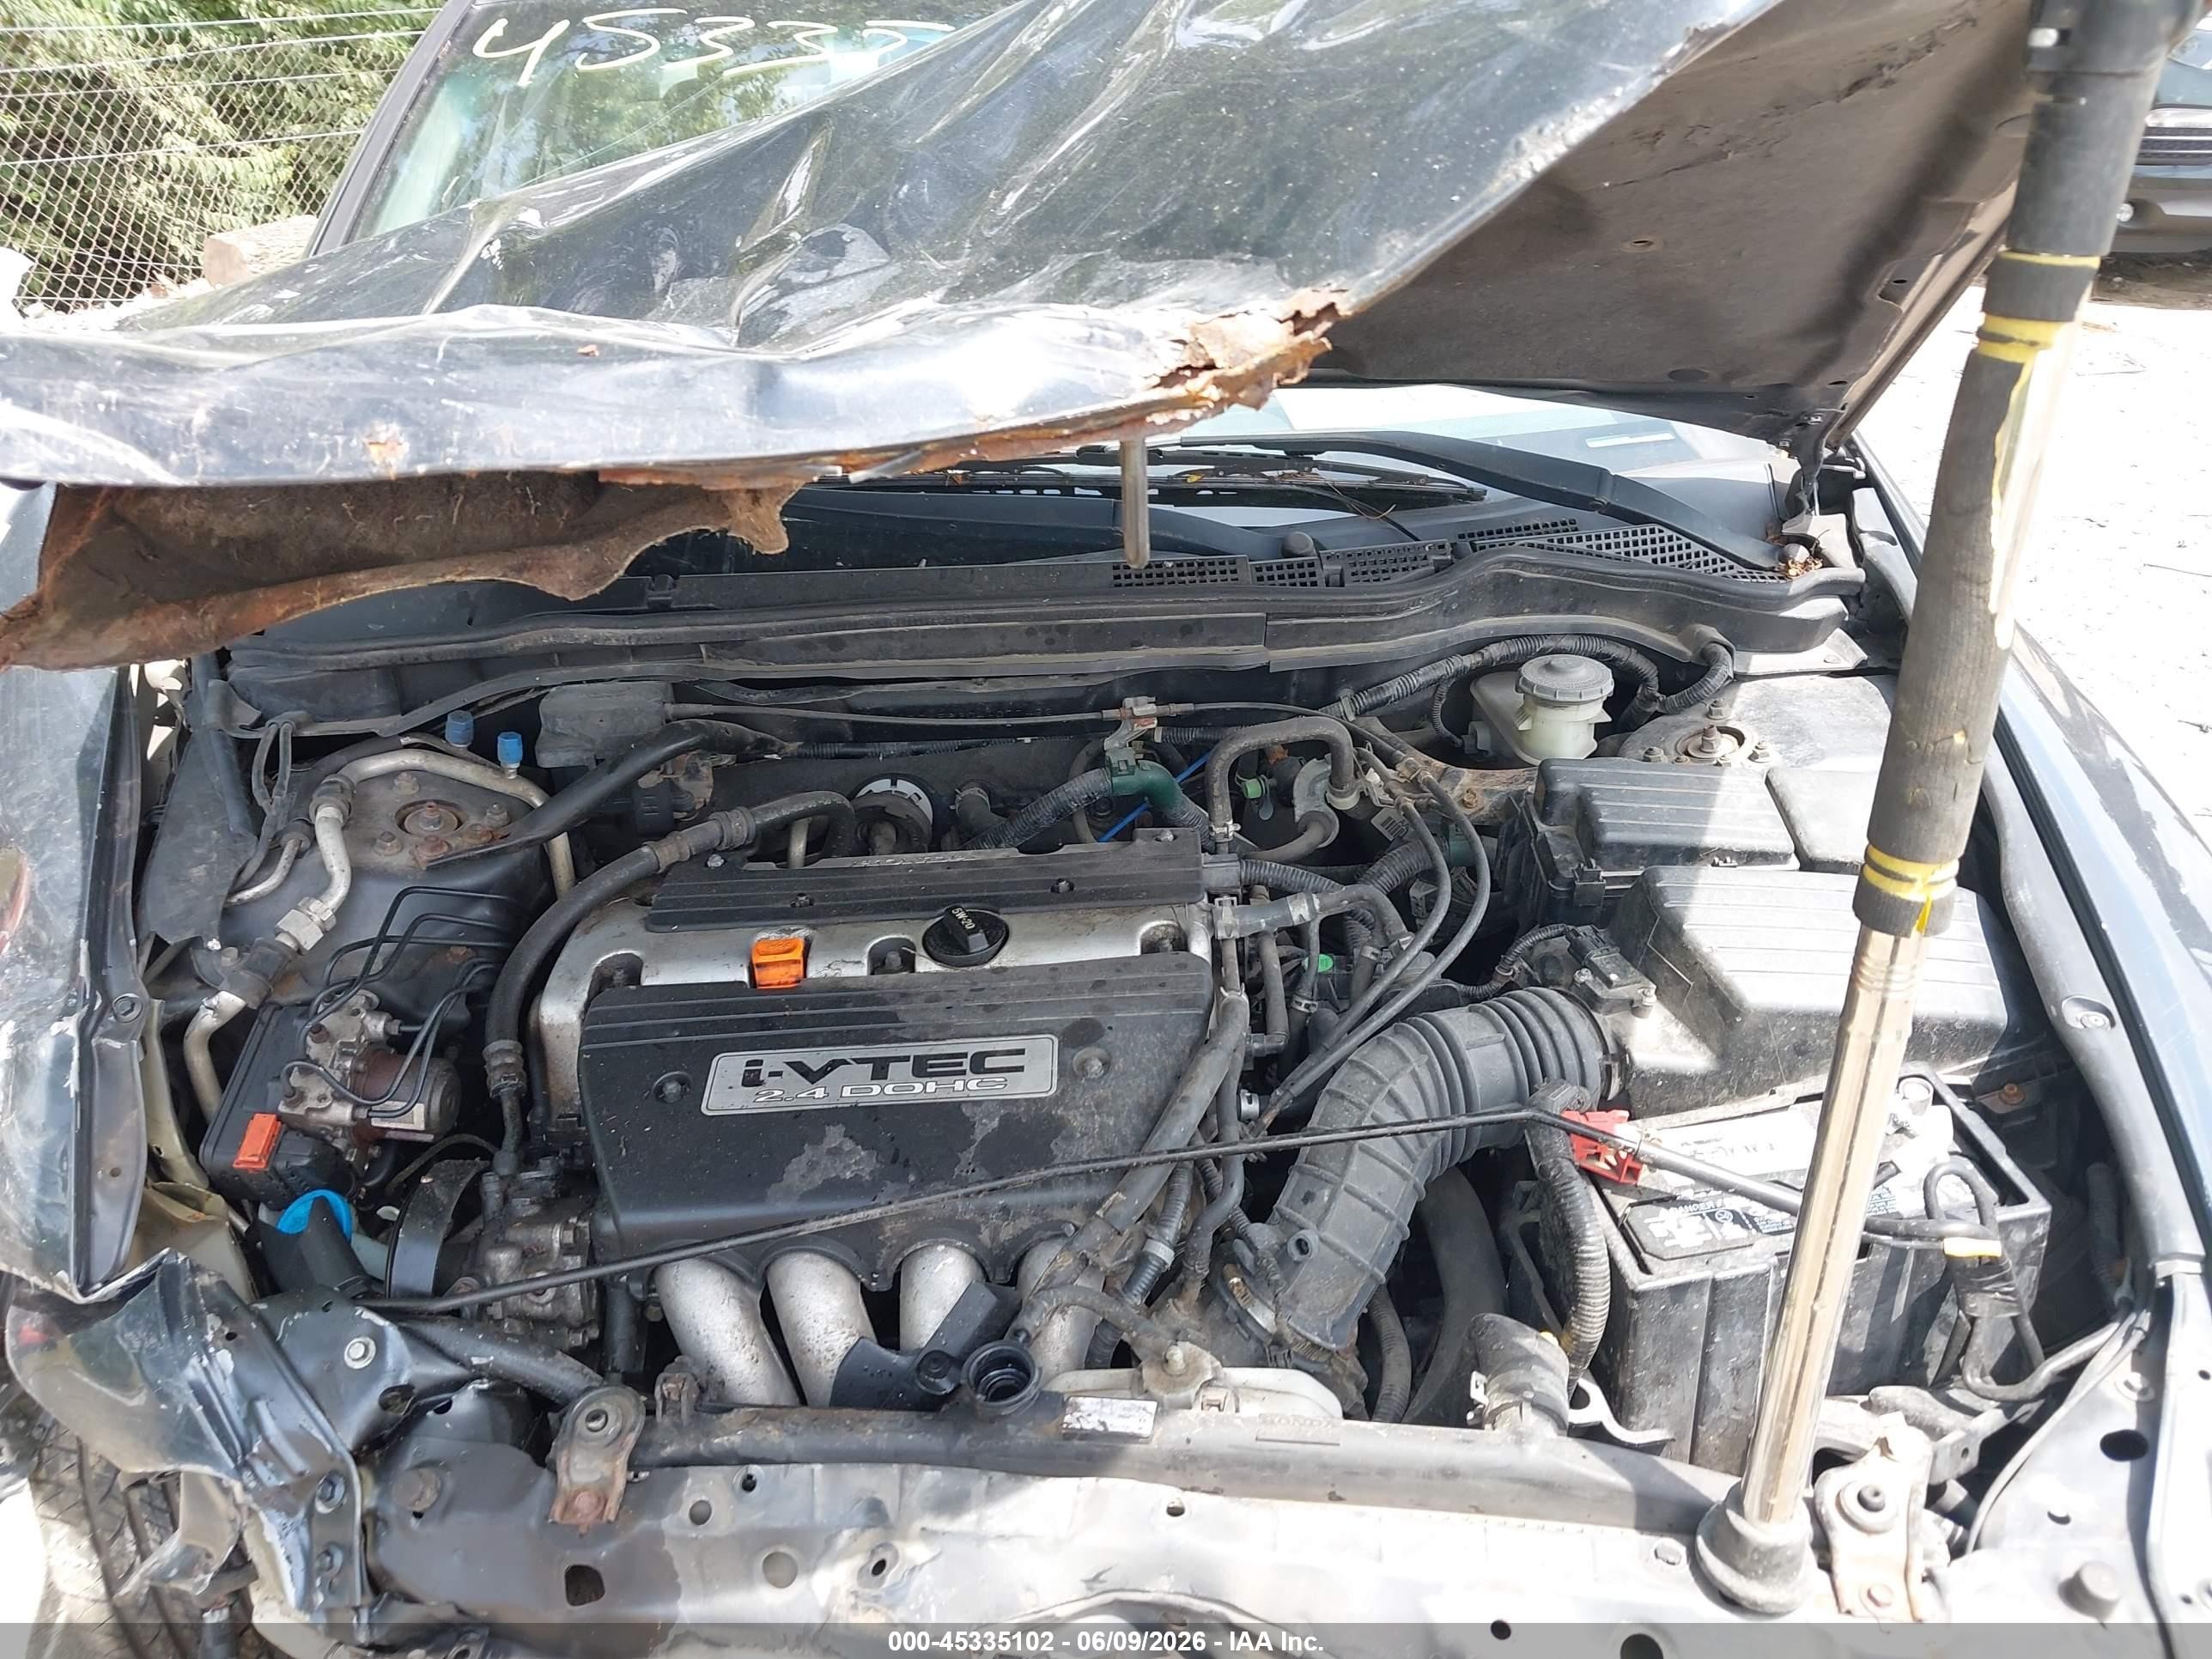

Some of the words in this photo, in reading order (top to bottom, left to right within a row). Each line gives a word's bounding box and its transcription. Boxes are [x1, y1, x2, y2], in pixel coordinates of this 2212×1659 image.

[951, 907, 976, 930] 5W-20
[742, 1048, 1026, 1088] i-VTEC
[753, 1085, 830, 1103] 2.4
[840, 1077, 1008, 1098] DOHC
